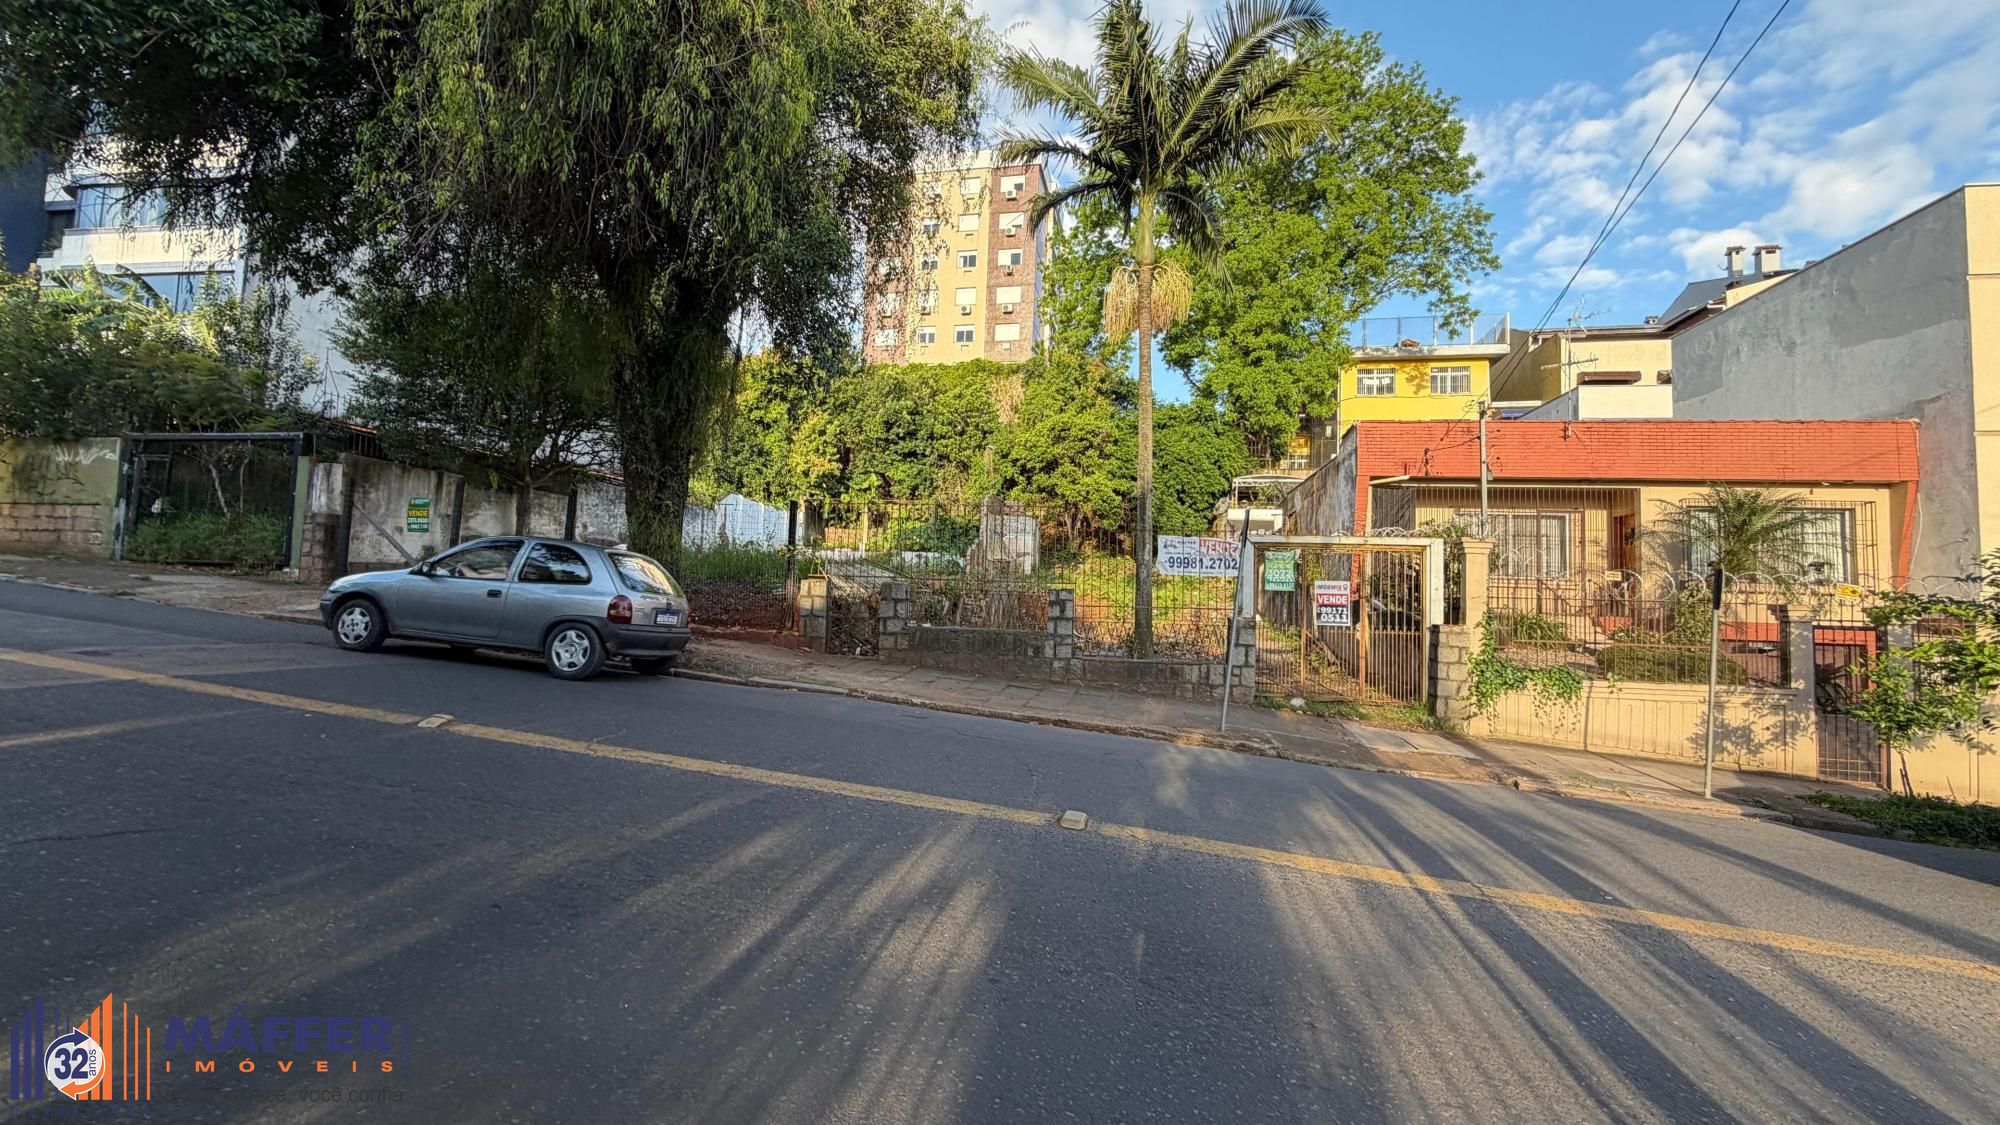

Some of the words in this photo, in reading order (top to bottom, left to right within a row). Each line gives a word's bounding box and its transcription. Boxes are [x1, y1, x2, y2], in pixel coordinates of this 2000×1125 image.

[1200, 539, 1239, 556] VENDE
[1168, 556, 1238, 570] 99981.2702
[1267, 569, 1291, 577] 3072
[1317, 595, 1347, 604] VENDE
[1320, 606, 1347, 614] 99171
[1320, 613, 1347, 622] 0511
